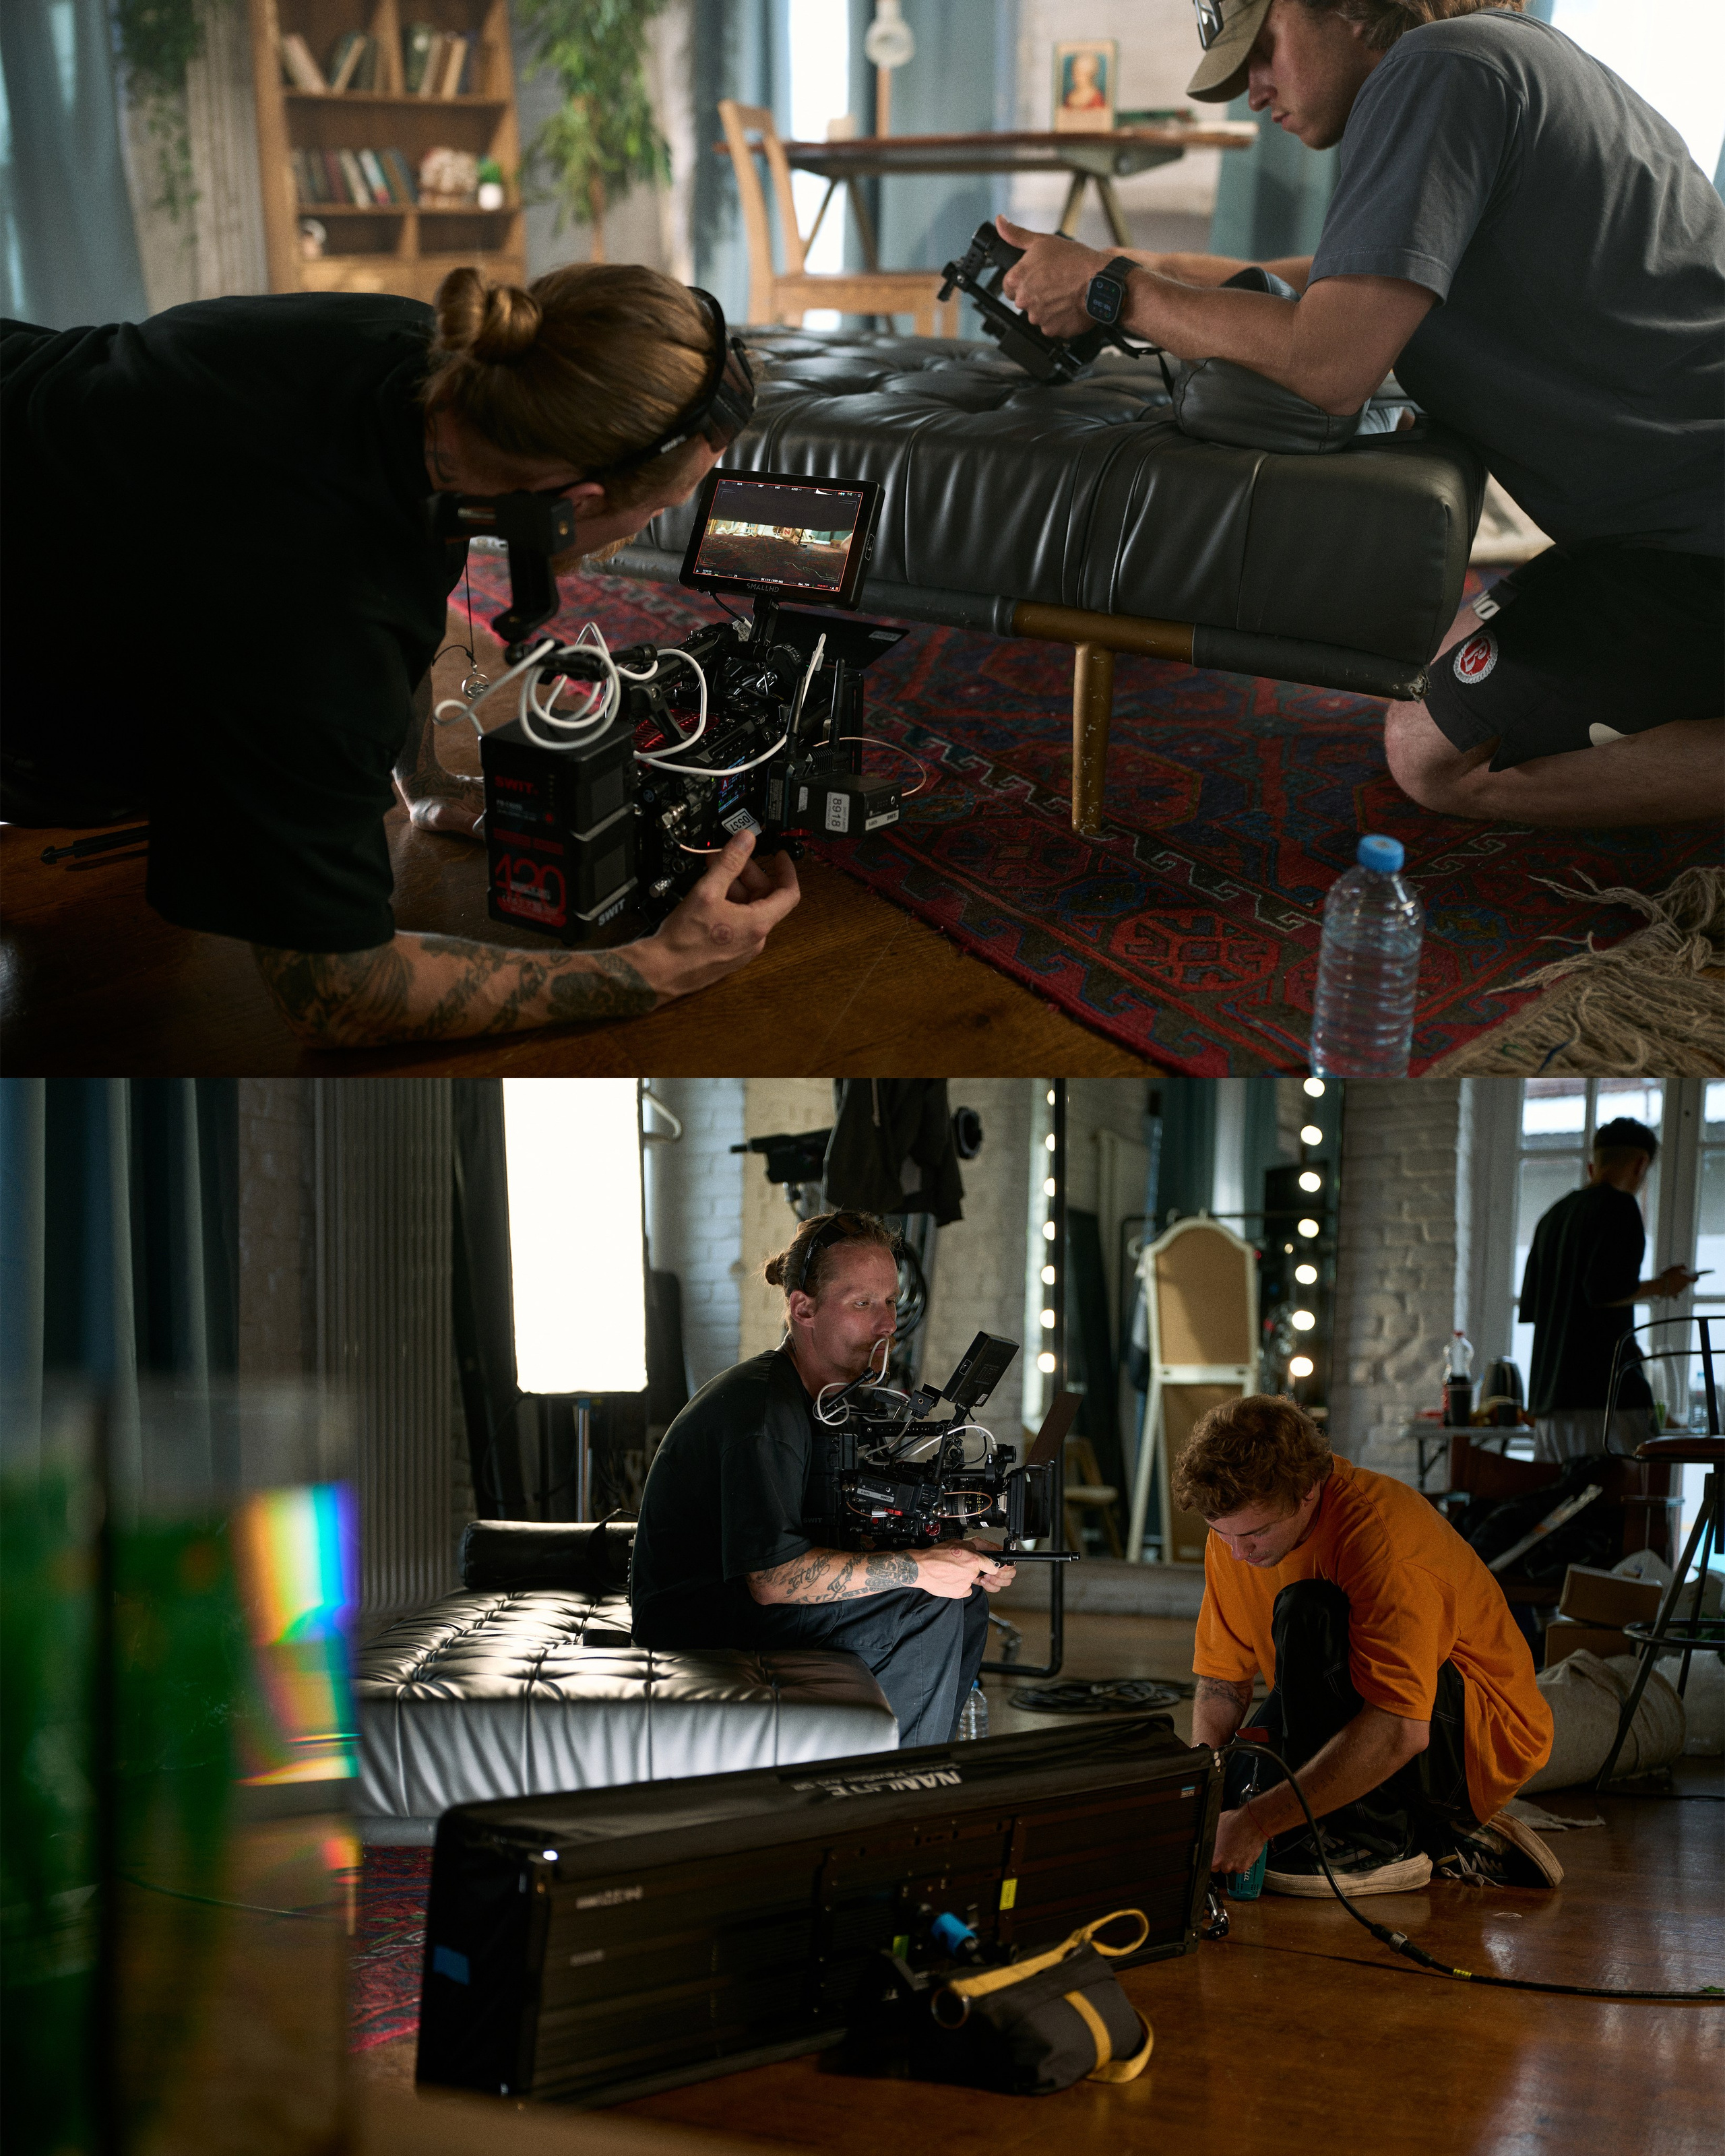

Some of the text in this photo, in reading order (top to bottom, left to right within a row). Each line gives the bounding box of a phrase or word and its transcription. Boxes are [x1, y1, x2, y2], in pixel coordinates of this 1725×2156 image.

[746, 583, 780, 592] SMALLHD
[722, 779, 728, 790] A
[831, 798, 842, 827] 8918
[730, 815, 751, 831] 0537
[598, 897, 625, 926] SWIT
